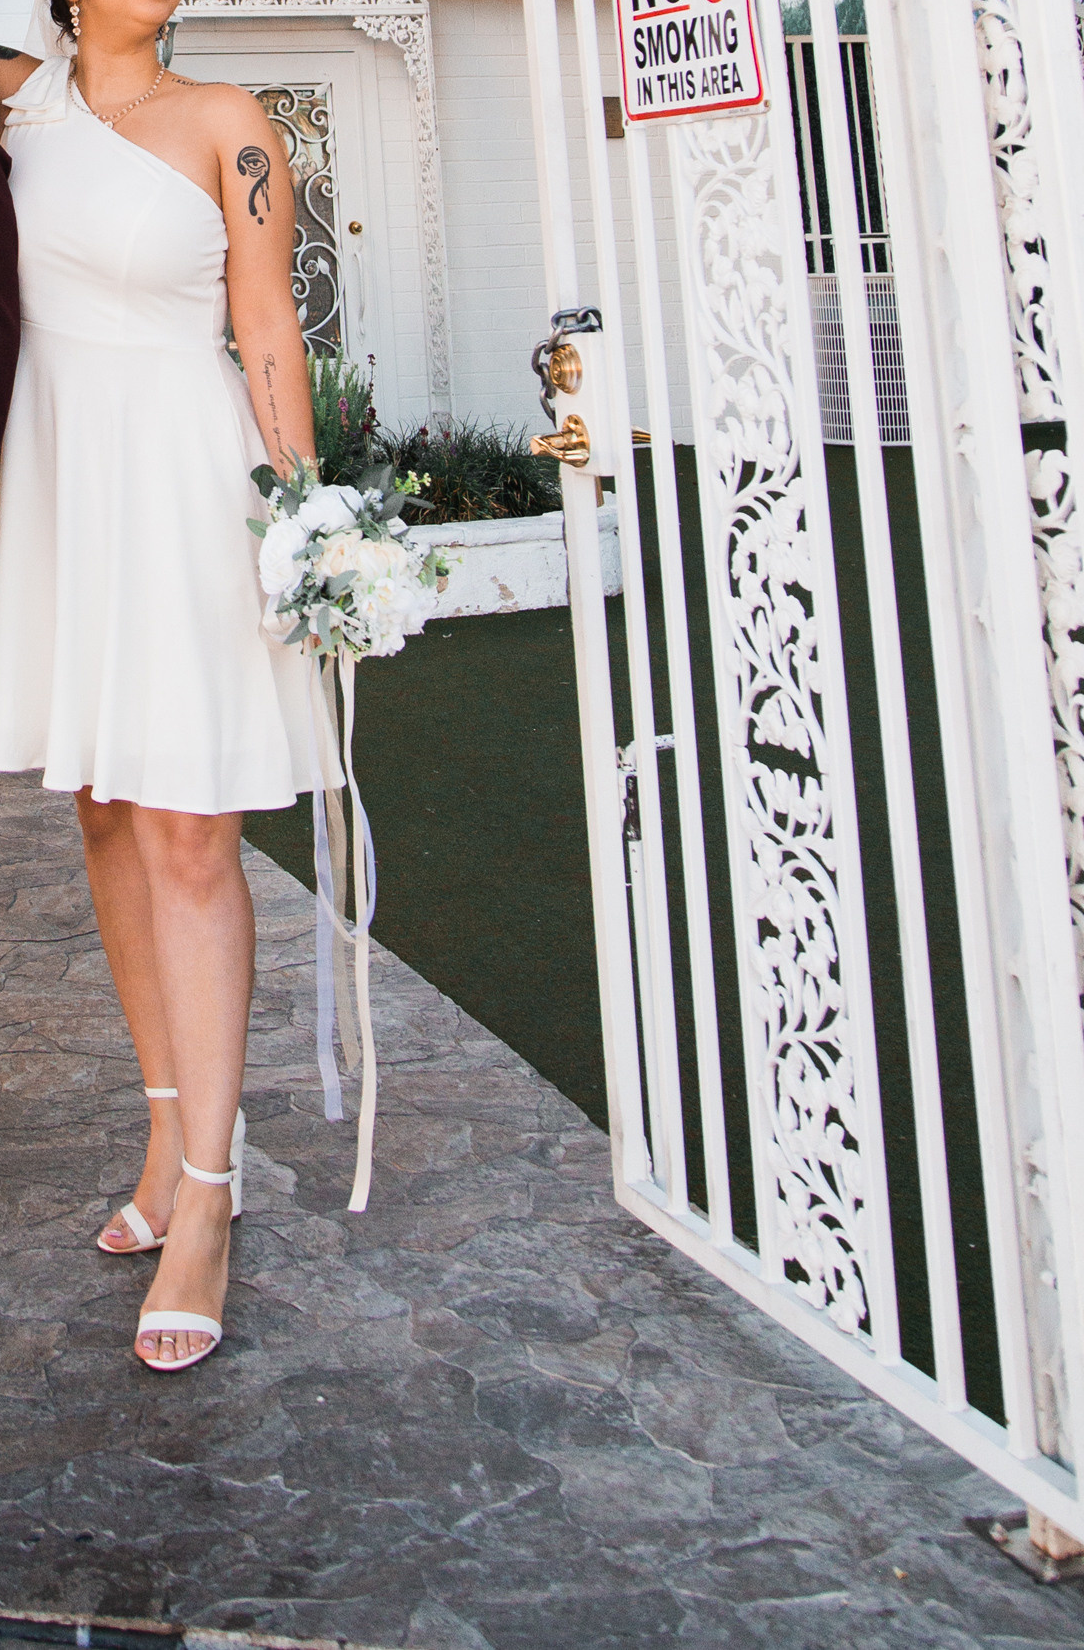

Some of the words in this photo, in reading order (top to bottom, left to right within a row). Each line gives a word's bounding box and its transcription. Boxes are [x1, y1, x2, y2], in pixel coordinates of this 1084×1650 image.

[633, 9, 738, 69] SMOKING
[637, 77, 653, 106] IN
[656, 70, 696, 104] THIS
[701, 62, 744, 98] AREA
